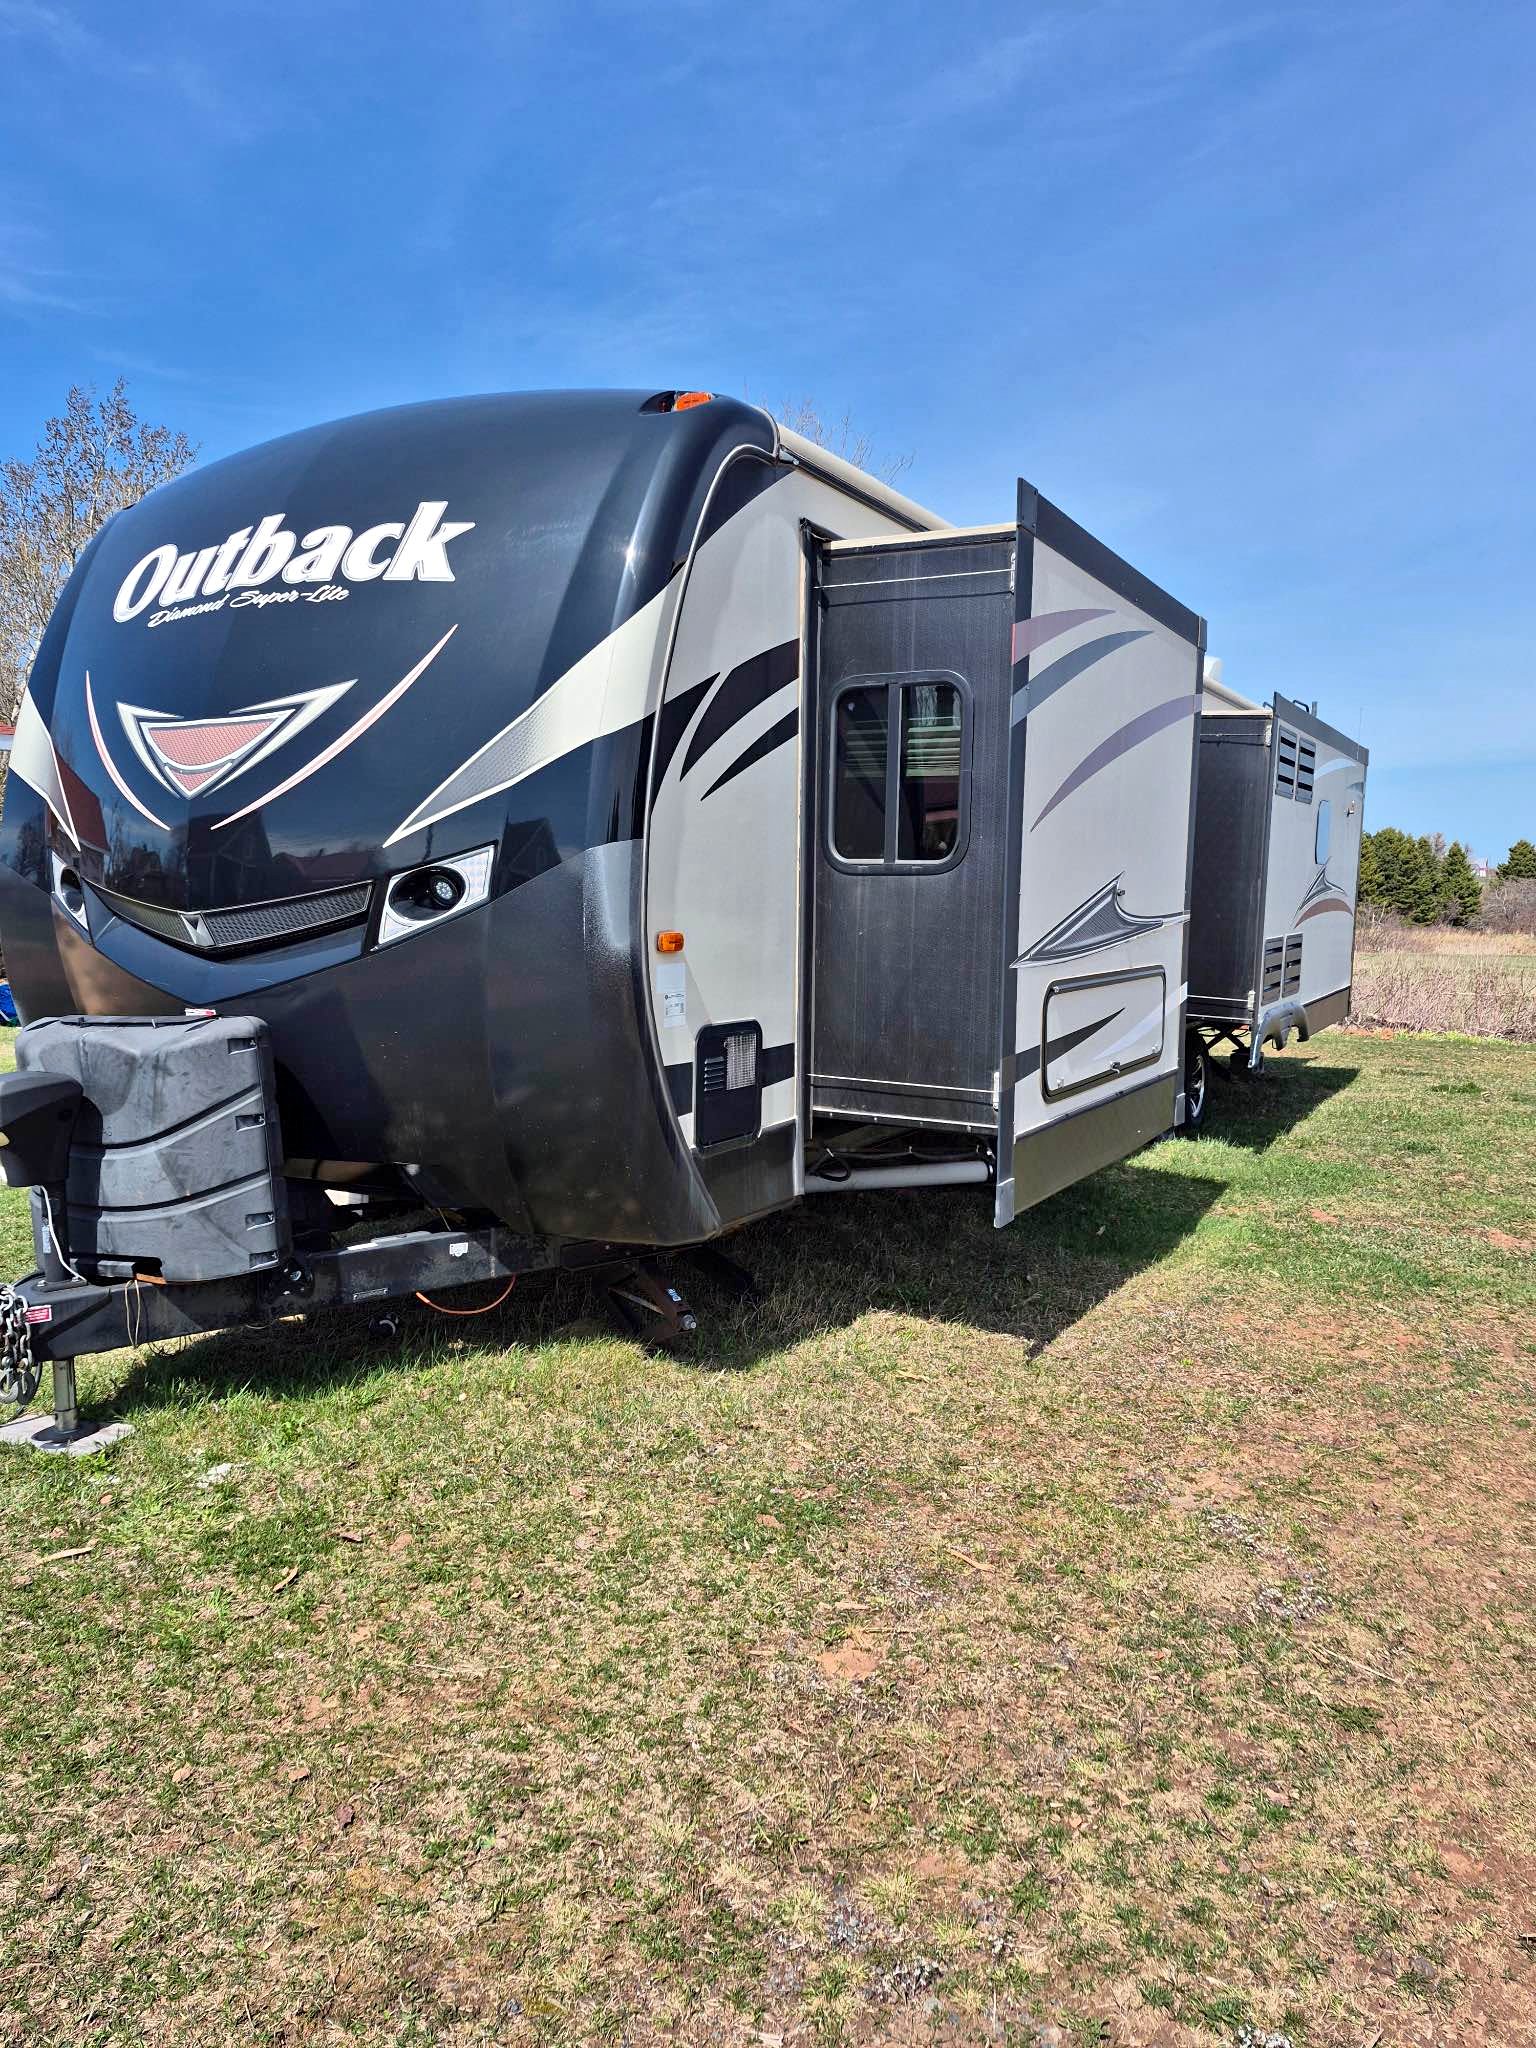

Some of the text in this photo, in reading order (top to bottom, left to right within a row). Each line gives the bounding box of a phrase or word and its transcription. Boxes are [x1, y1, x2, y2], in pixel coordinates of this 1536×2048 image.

[113, 501, 476, 623] Outback
[147, 584, 350, 627] Diamond Super-Lite
